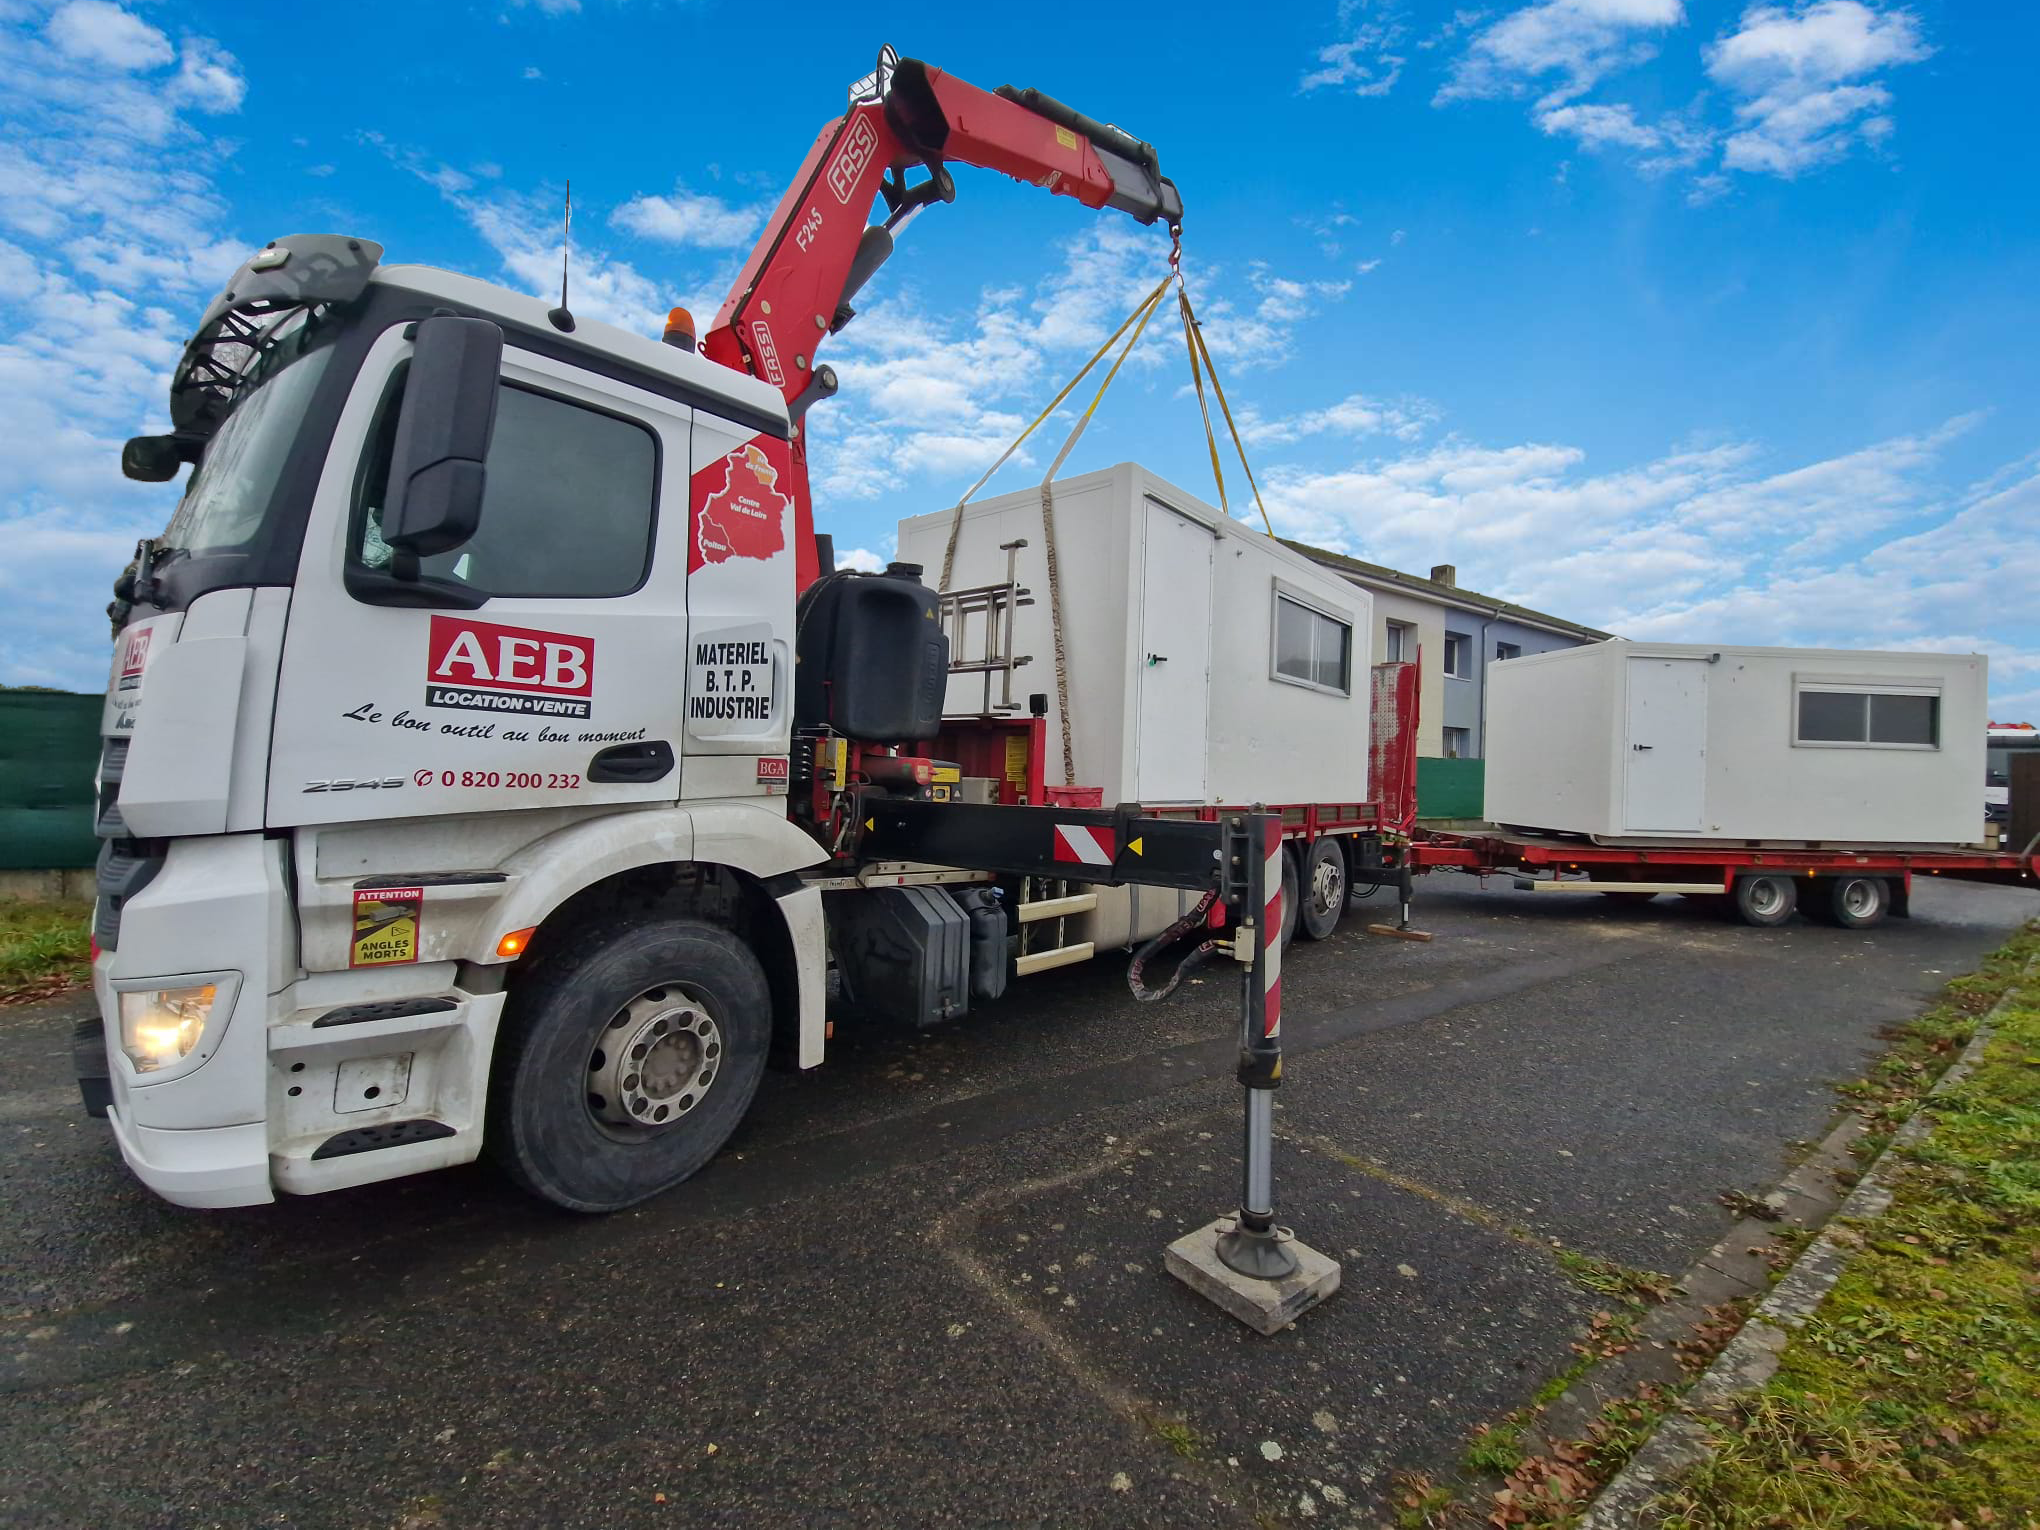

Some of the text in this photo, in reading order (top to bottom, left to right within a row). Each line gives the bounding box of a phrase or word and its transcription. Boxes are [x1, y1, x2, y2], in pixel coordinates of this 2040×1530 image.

[831, 120, 875, 197] FASSI
[795, 207, 823, 252] F245
[755, 326, 782, 384] FASSI
[730, 502, 741, 512] Val
[738, 495, 760, 508] Centre
[703, 539, 726, 551] Poitou
[435, 630, 588, 690] AEB
[696, 641, 769, 666] MATERIEL
[690, 696, 770, 720] INDUSTRIE
[342, 703, 645, 743] Le bon outil au bon moment
[760, 761, 785, 775] BGA
[302, 775, 406, 793] 2545
[441, 770, 580, 789] 0 820 200 232
[358, 890, 419, 901] ATTENTION
[361, 939, 409, 952] ANGLES
[363, 949, 406, 960] MORTS
